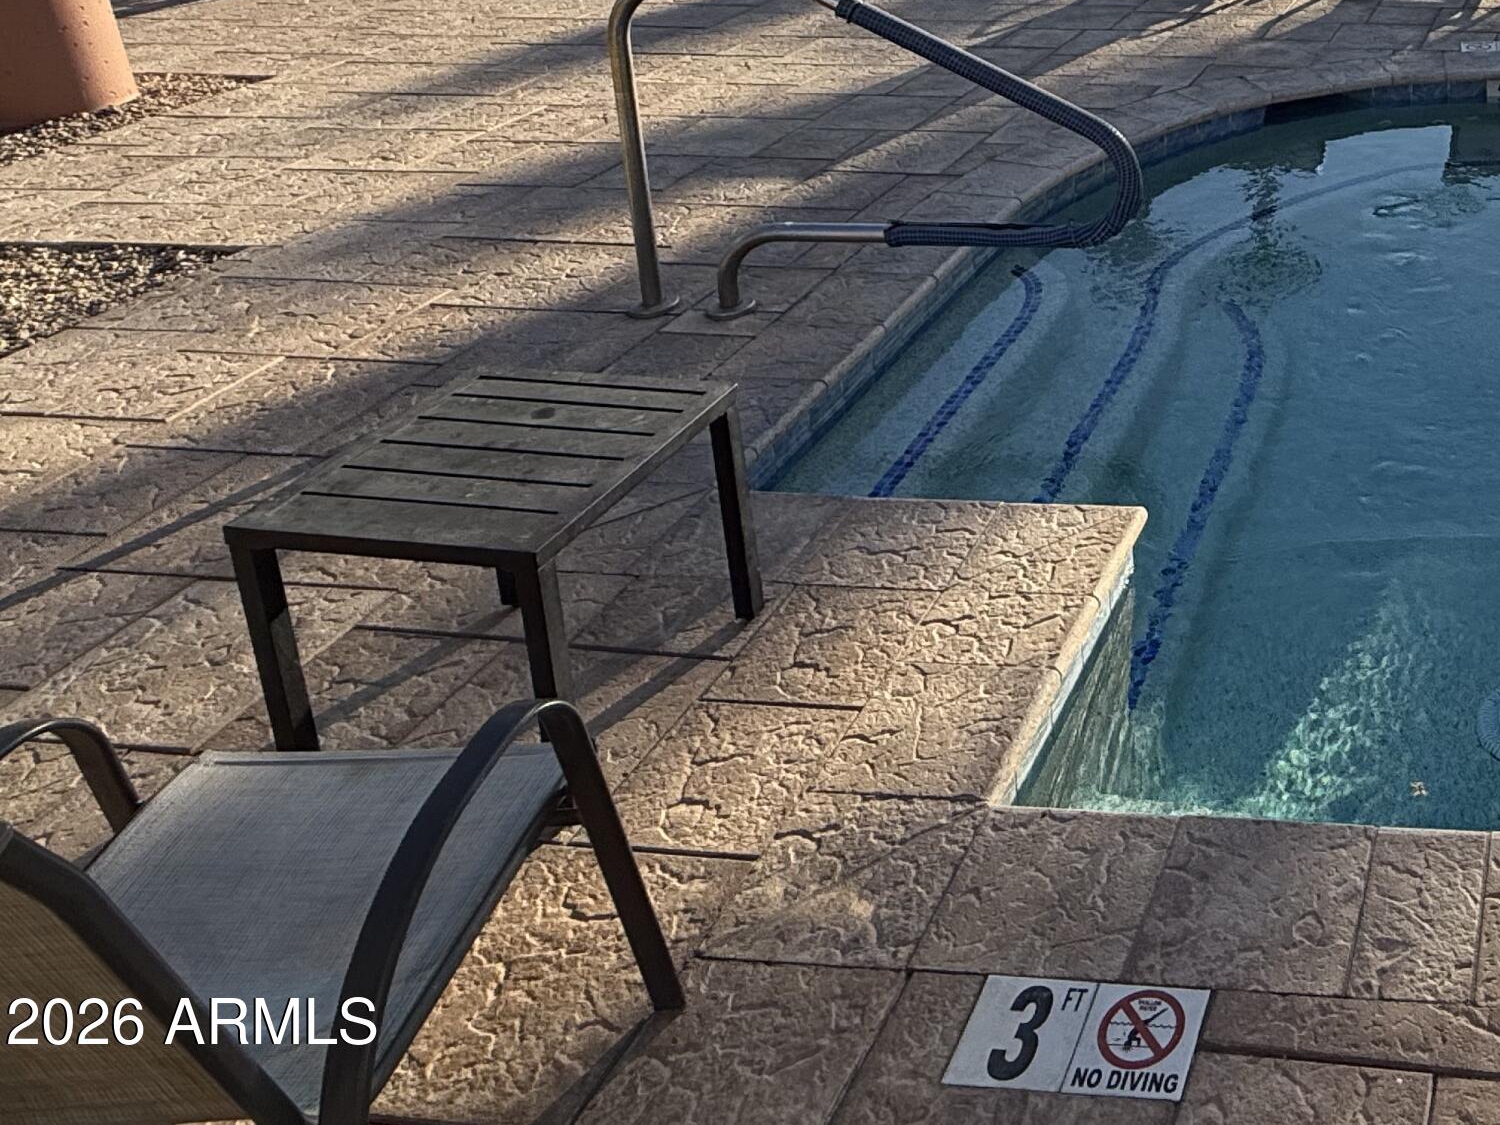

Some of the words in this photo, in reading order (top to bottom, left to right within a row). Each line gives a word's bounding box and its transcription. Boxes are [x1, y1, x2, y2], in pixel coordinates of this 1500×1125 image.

[987, 985, 1054, 1081] 3
[1061, 988, 1088, 1012] FT
[1070, 1067, 1103, 1088] NO
[1106, 1070, 1179, 1093] DIVING
